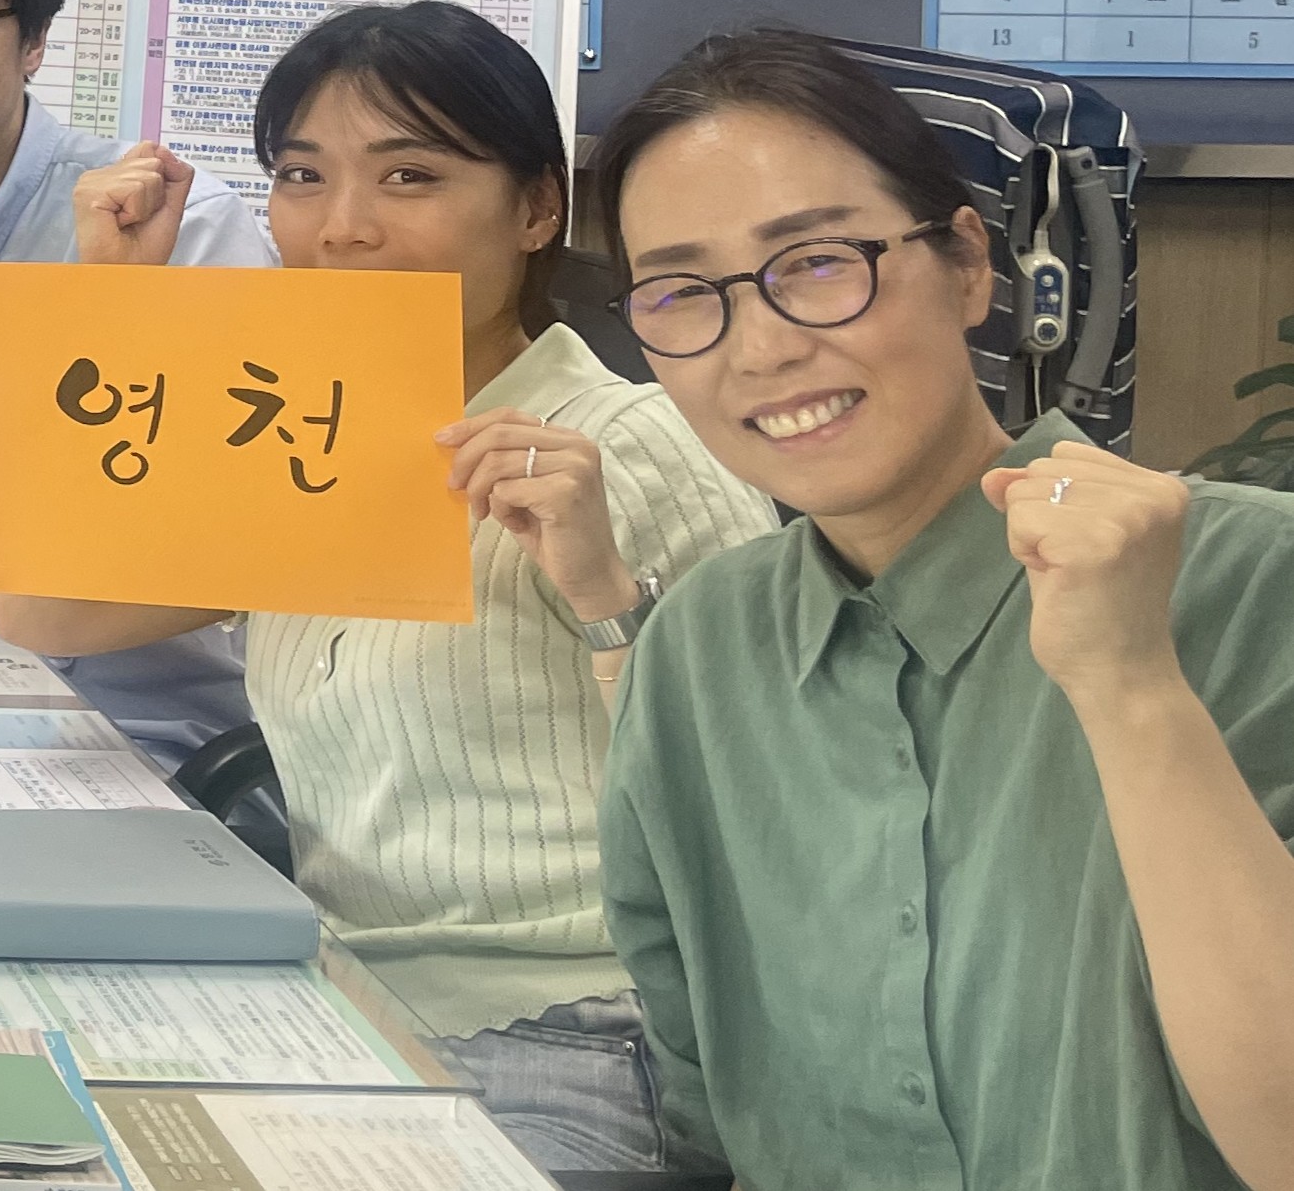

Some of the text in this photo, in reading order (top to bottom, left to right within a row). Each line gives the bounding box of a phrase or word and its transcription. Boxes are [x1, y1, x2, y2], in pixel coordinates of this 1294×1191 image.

[991, 28, 1012, 46] 13
[1126, 30, 1135, 48] 1
[1248, 31, 1259, 50] 5
